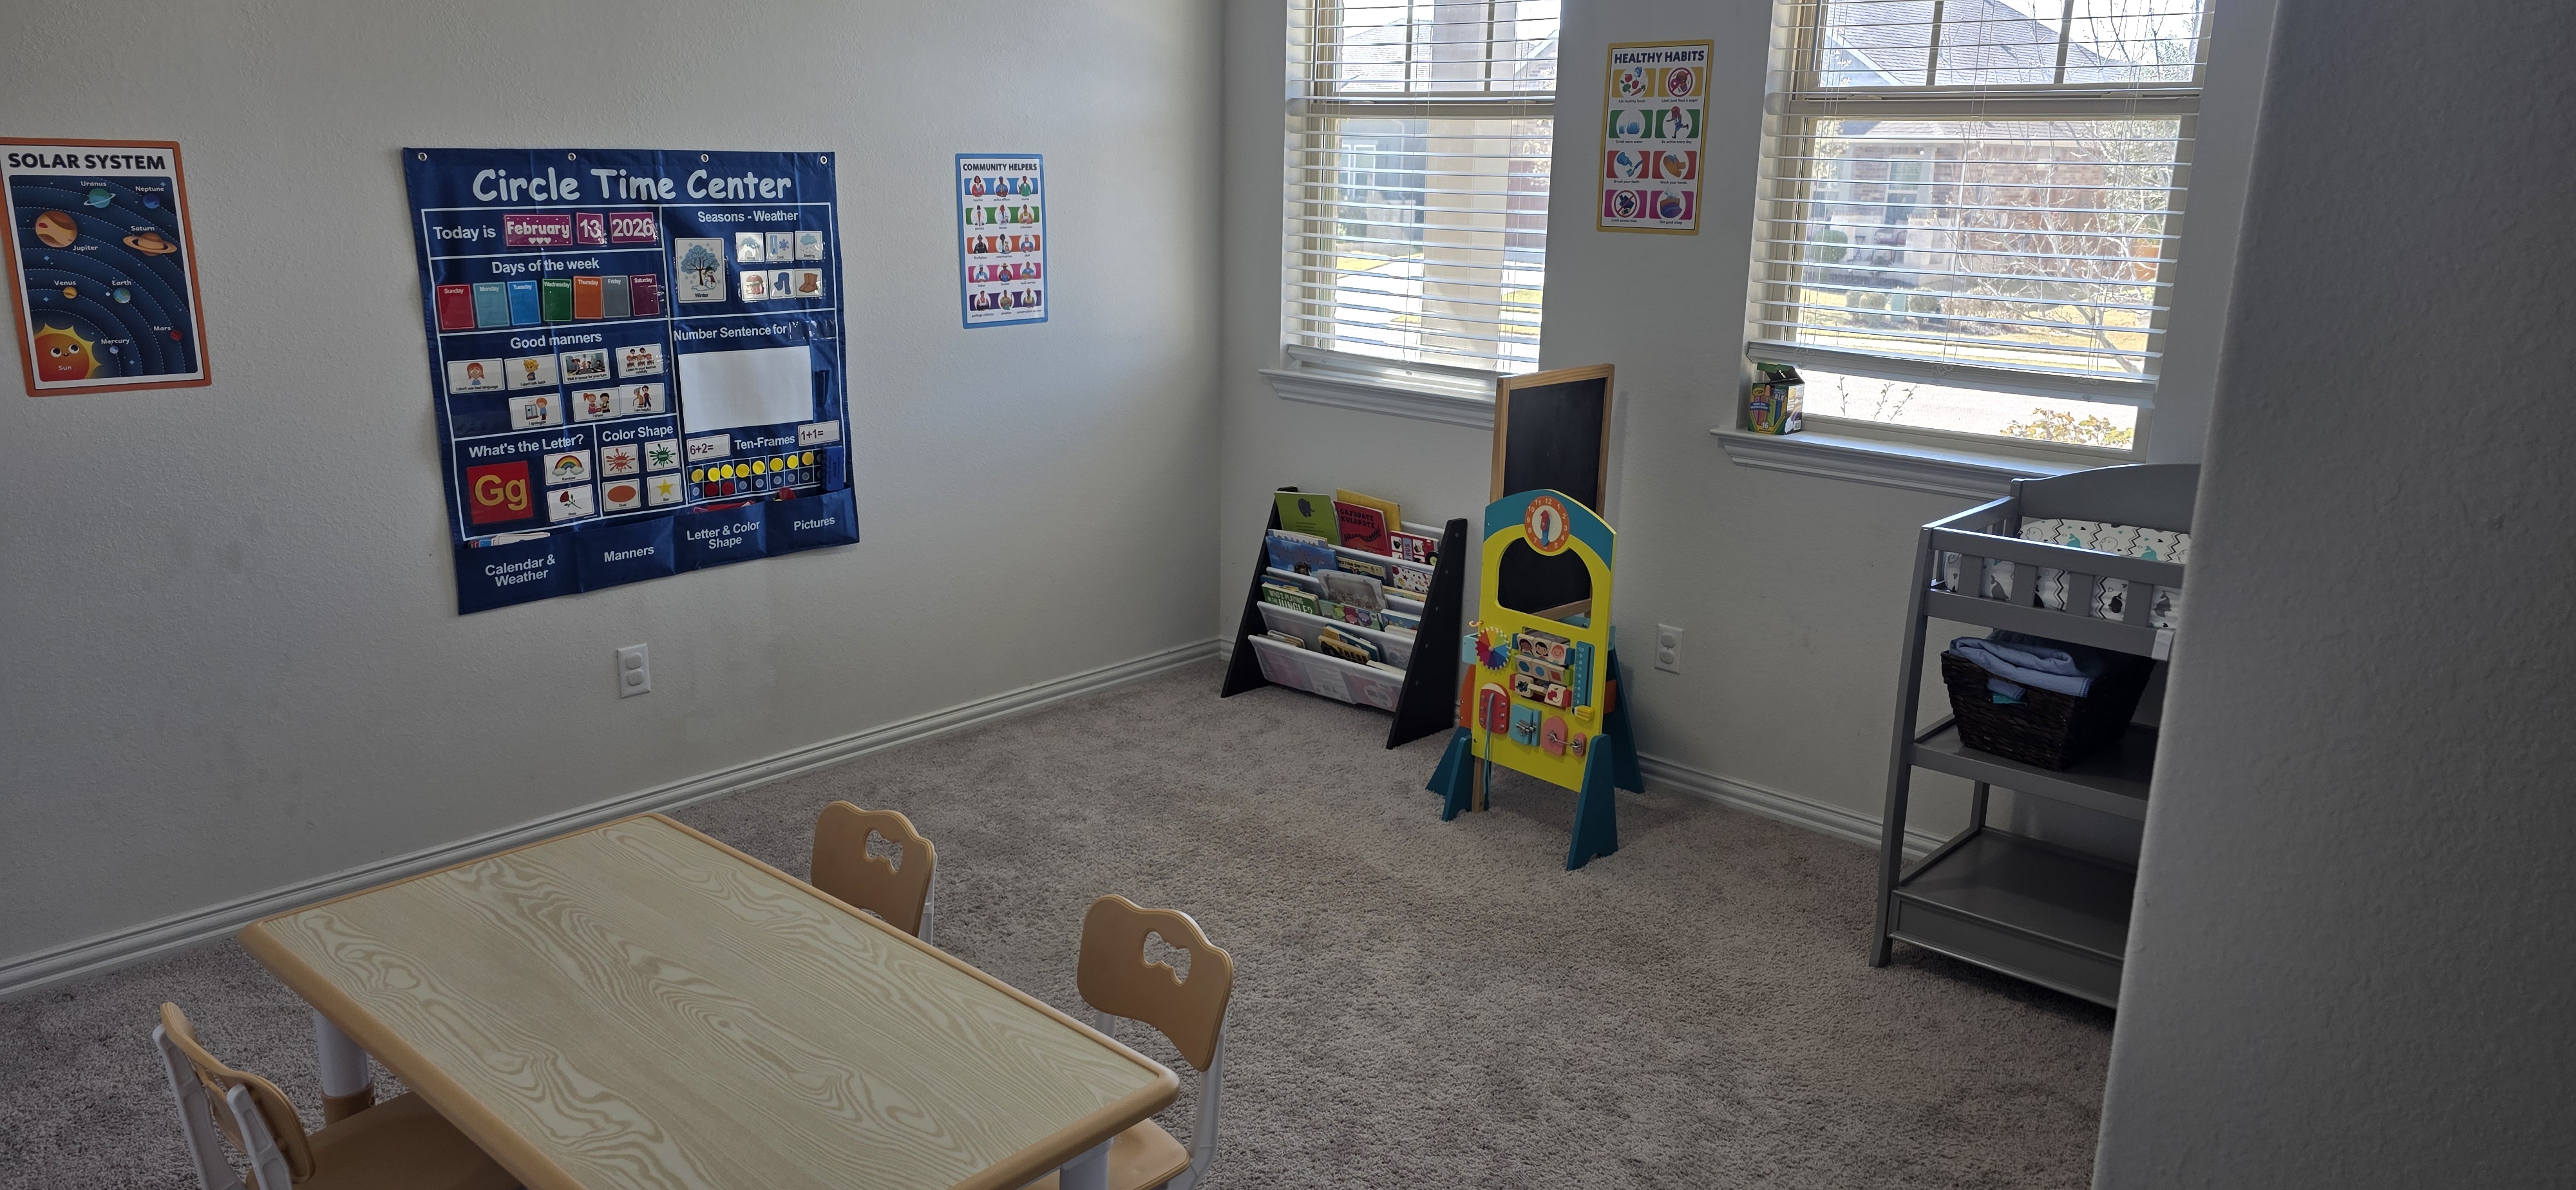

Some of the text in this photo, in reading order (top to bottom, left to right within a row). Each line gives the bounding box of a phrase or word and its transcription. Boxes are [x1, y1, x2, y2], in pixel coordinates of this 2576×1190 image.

[1615, 50, 1705, 64] HEALTHY HABITS
[8, 152, 166, 170] SOLAR SYSTEM
[963, 163, 1037, 171] COMMUNITY HELPERS
[135, 185, 164, 193] Neptune
[473, 166, 791, 202] Circle Time Center
[698, 211, 798, 223] Seasons Weather
[433, 218, 654, 242] Today is February 13 2026
[492, 257, 600, 276] Days of the week
[674, 324, 787, 341] Number Sentence for
[510, 333, 603, 349] Good manners
[1774, 393, 1785, 401] ALK
[602, 425, 674, 442] Color Shape
[800, 429, 824, 440] 1+1=
[469, 434, 584, 458] What's the Letter?
[689, 443, 714, 455] 6+2=
[734, 434, 795, 450] Ten-Frames
[474, 474, 528, 511] Gg
[1340, 508, 1374, 522] GAJAPATI
[1341, 515, 1375, 529] KULAPATI
[687, 520, 760, 541] Letter & Color
[793, 516, 835, 531] Pictures
[708, 536, 742, 550] Shape
[604, 546, 655, 562] Manners
[485, 554, 556, 576] Calendar &
[495, 570, 549, 587] Weather
[1269, 590, 1304, 604] WHO'S PLAYING
